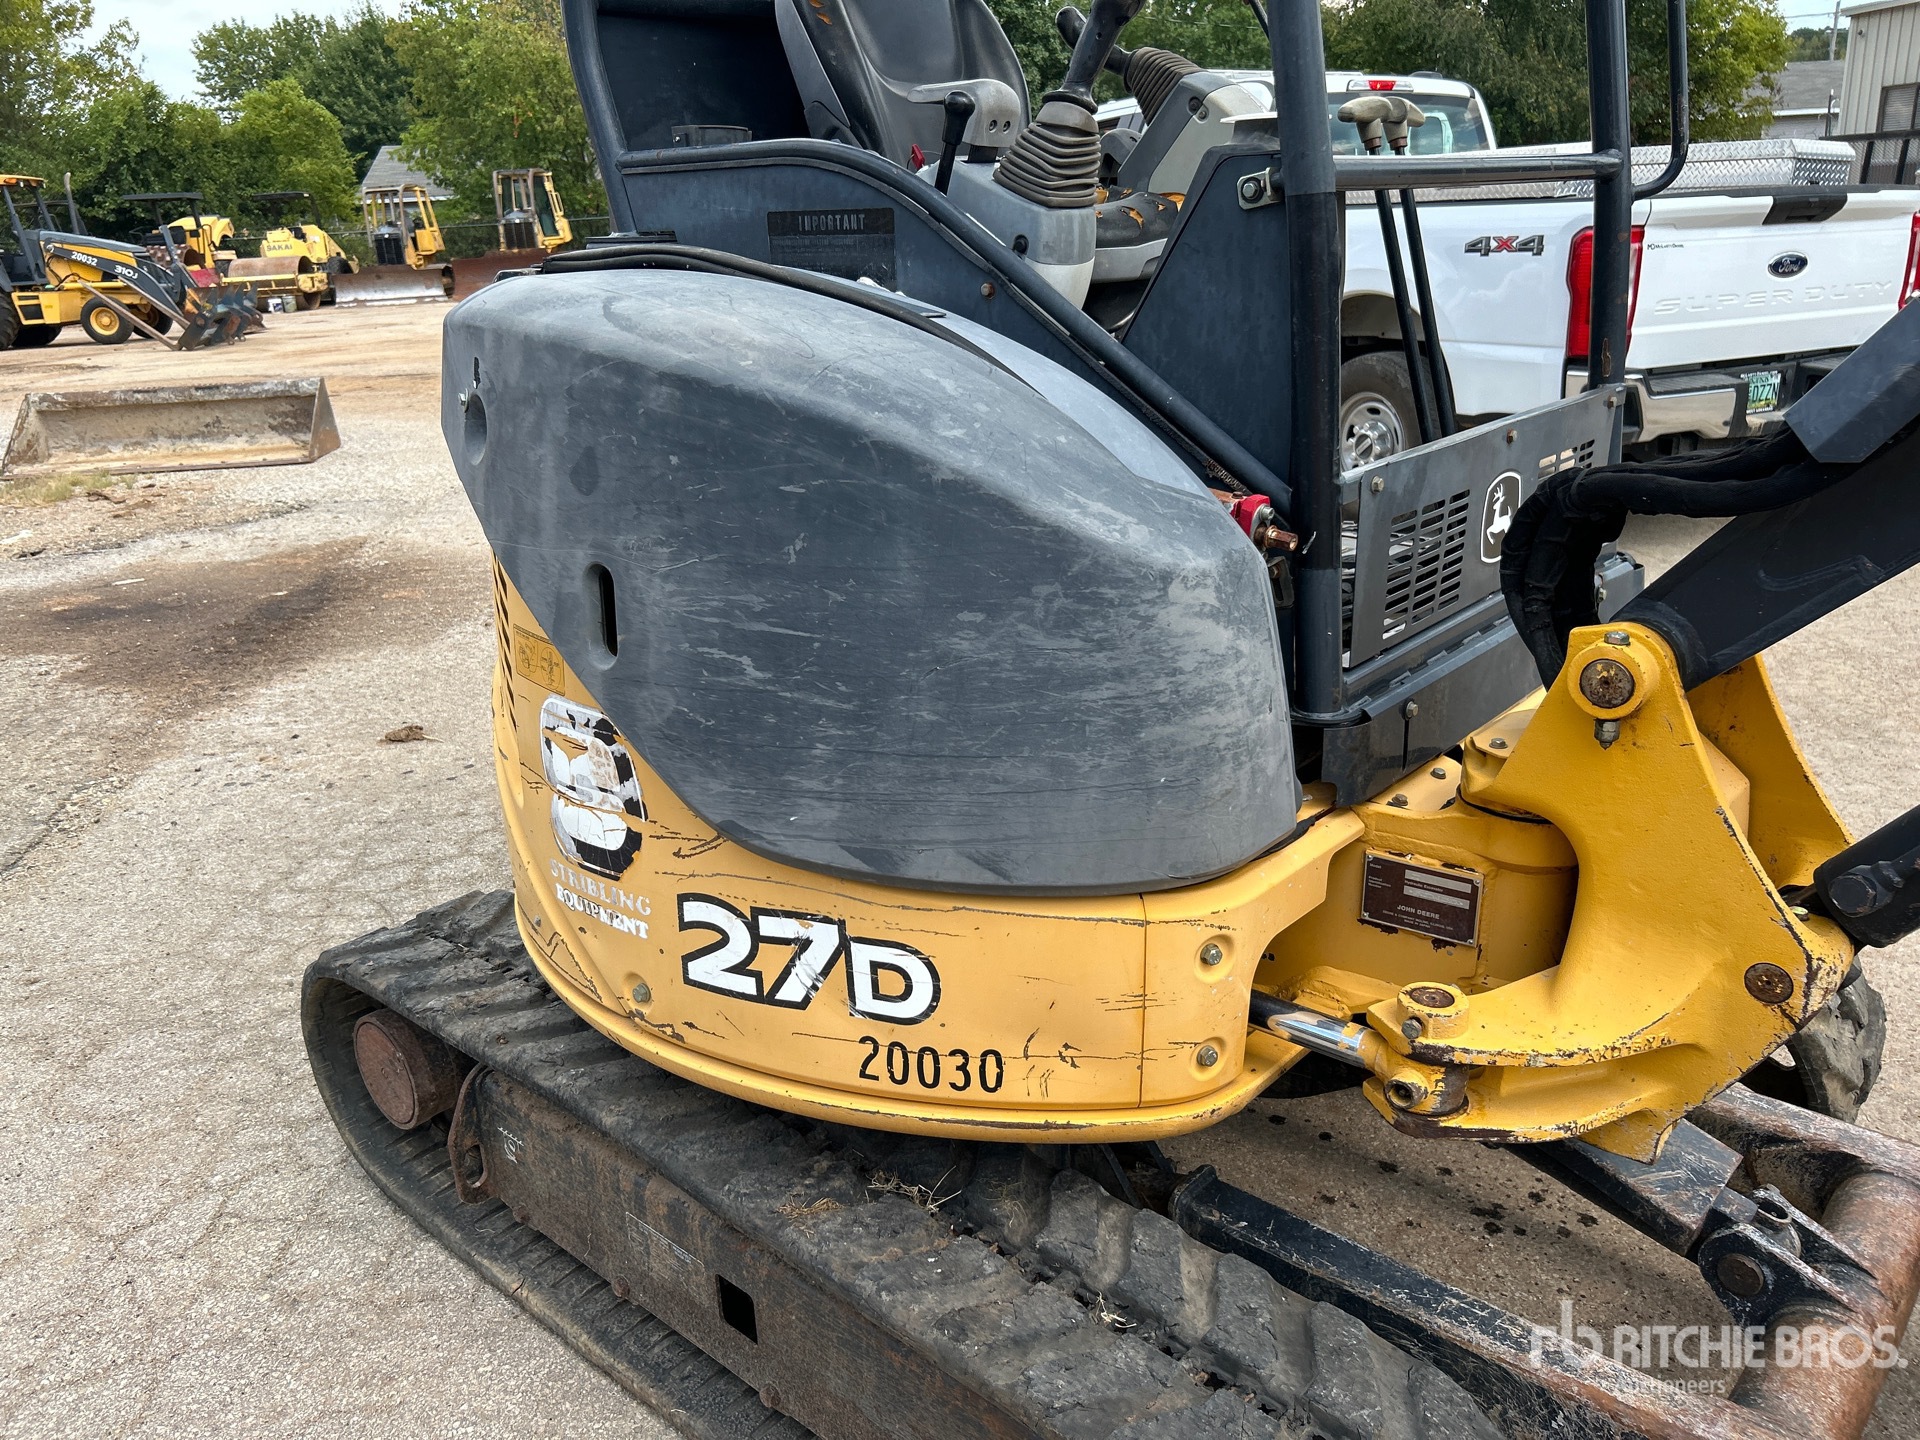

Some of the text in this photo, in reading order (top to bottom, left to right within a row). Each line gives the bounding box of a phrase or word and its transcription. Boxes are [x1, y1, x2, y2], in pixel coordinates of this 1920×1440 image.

[798, 212, 866, 232] IMPORTANT
[266, 243, 293, 252] SAKAI
[71, 251, 98, 267] 20032
[1778, 256, 1802, 273] Ford
[114, 264, 139, 280] 310J
[1653, 279, 1892, 316] SUPER DUTY
[550, 857, 652, 916] STRIBLING
[555, 882, 649, 940] EQUIPMENT
[1396, 904, 1440, 920] JOHN DEERE
[677, 892, 942, 1026] 27D
[859, 1035, 1004, 1094] 20030
